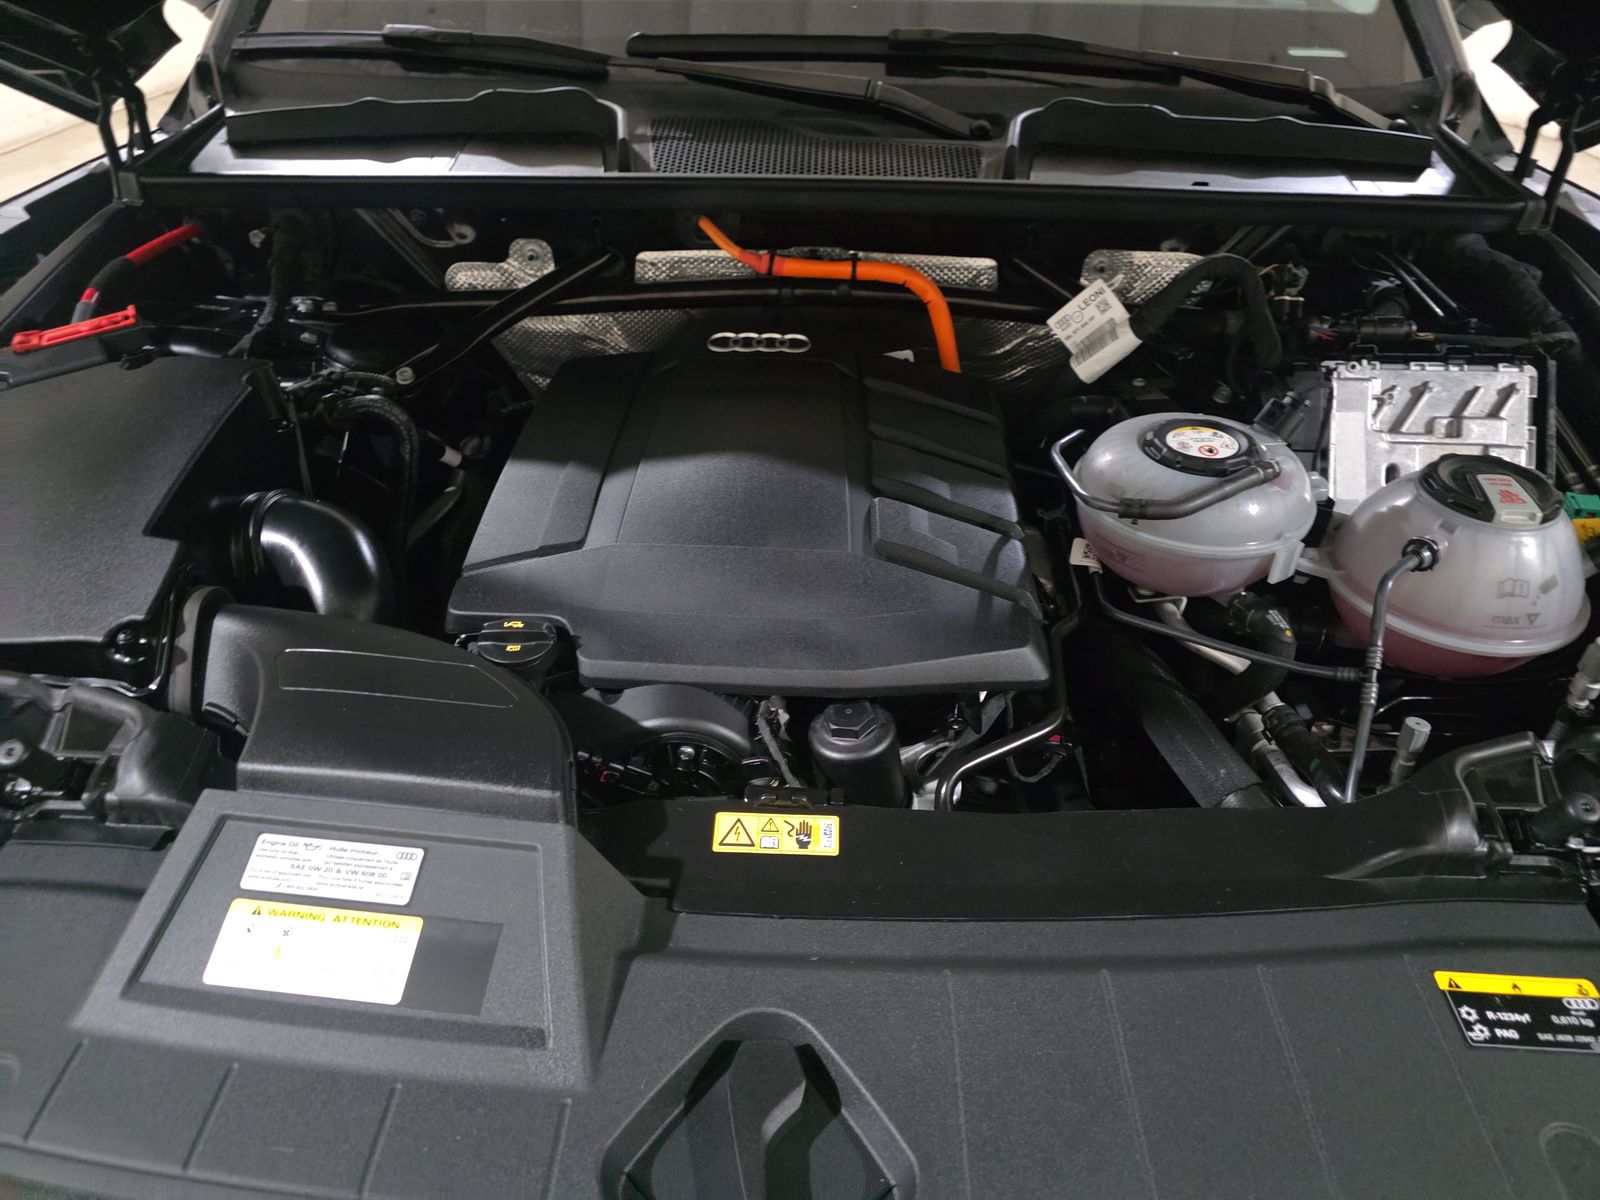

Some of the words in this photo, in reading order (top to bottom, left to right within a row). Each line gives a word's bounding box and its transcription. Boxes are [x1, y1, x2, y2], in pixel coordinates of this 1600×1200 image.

[1077, 286, 1106, 311] LEONI
[1492, 615, 1520, 625] max
[261, 838, 287, 847] Engine
[268, 909, 325, 922] WARNING
[333, 915, 400, 929] ATTENTION
[1494, 1028, 1520, 1039] PAG
